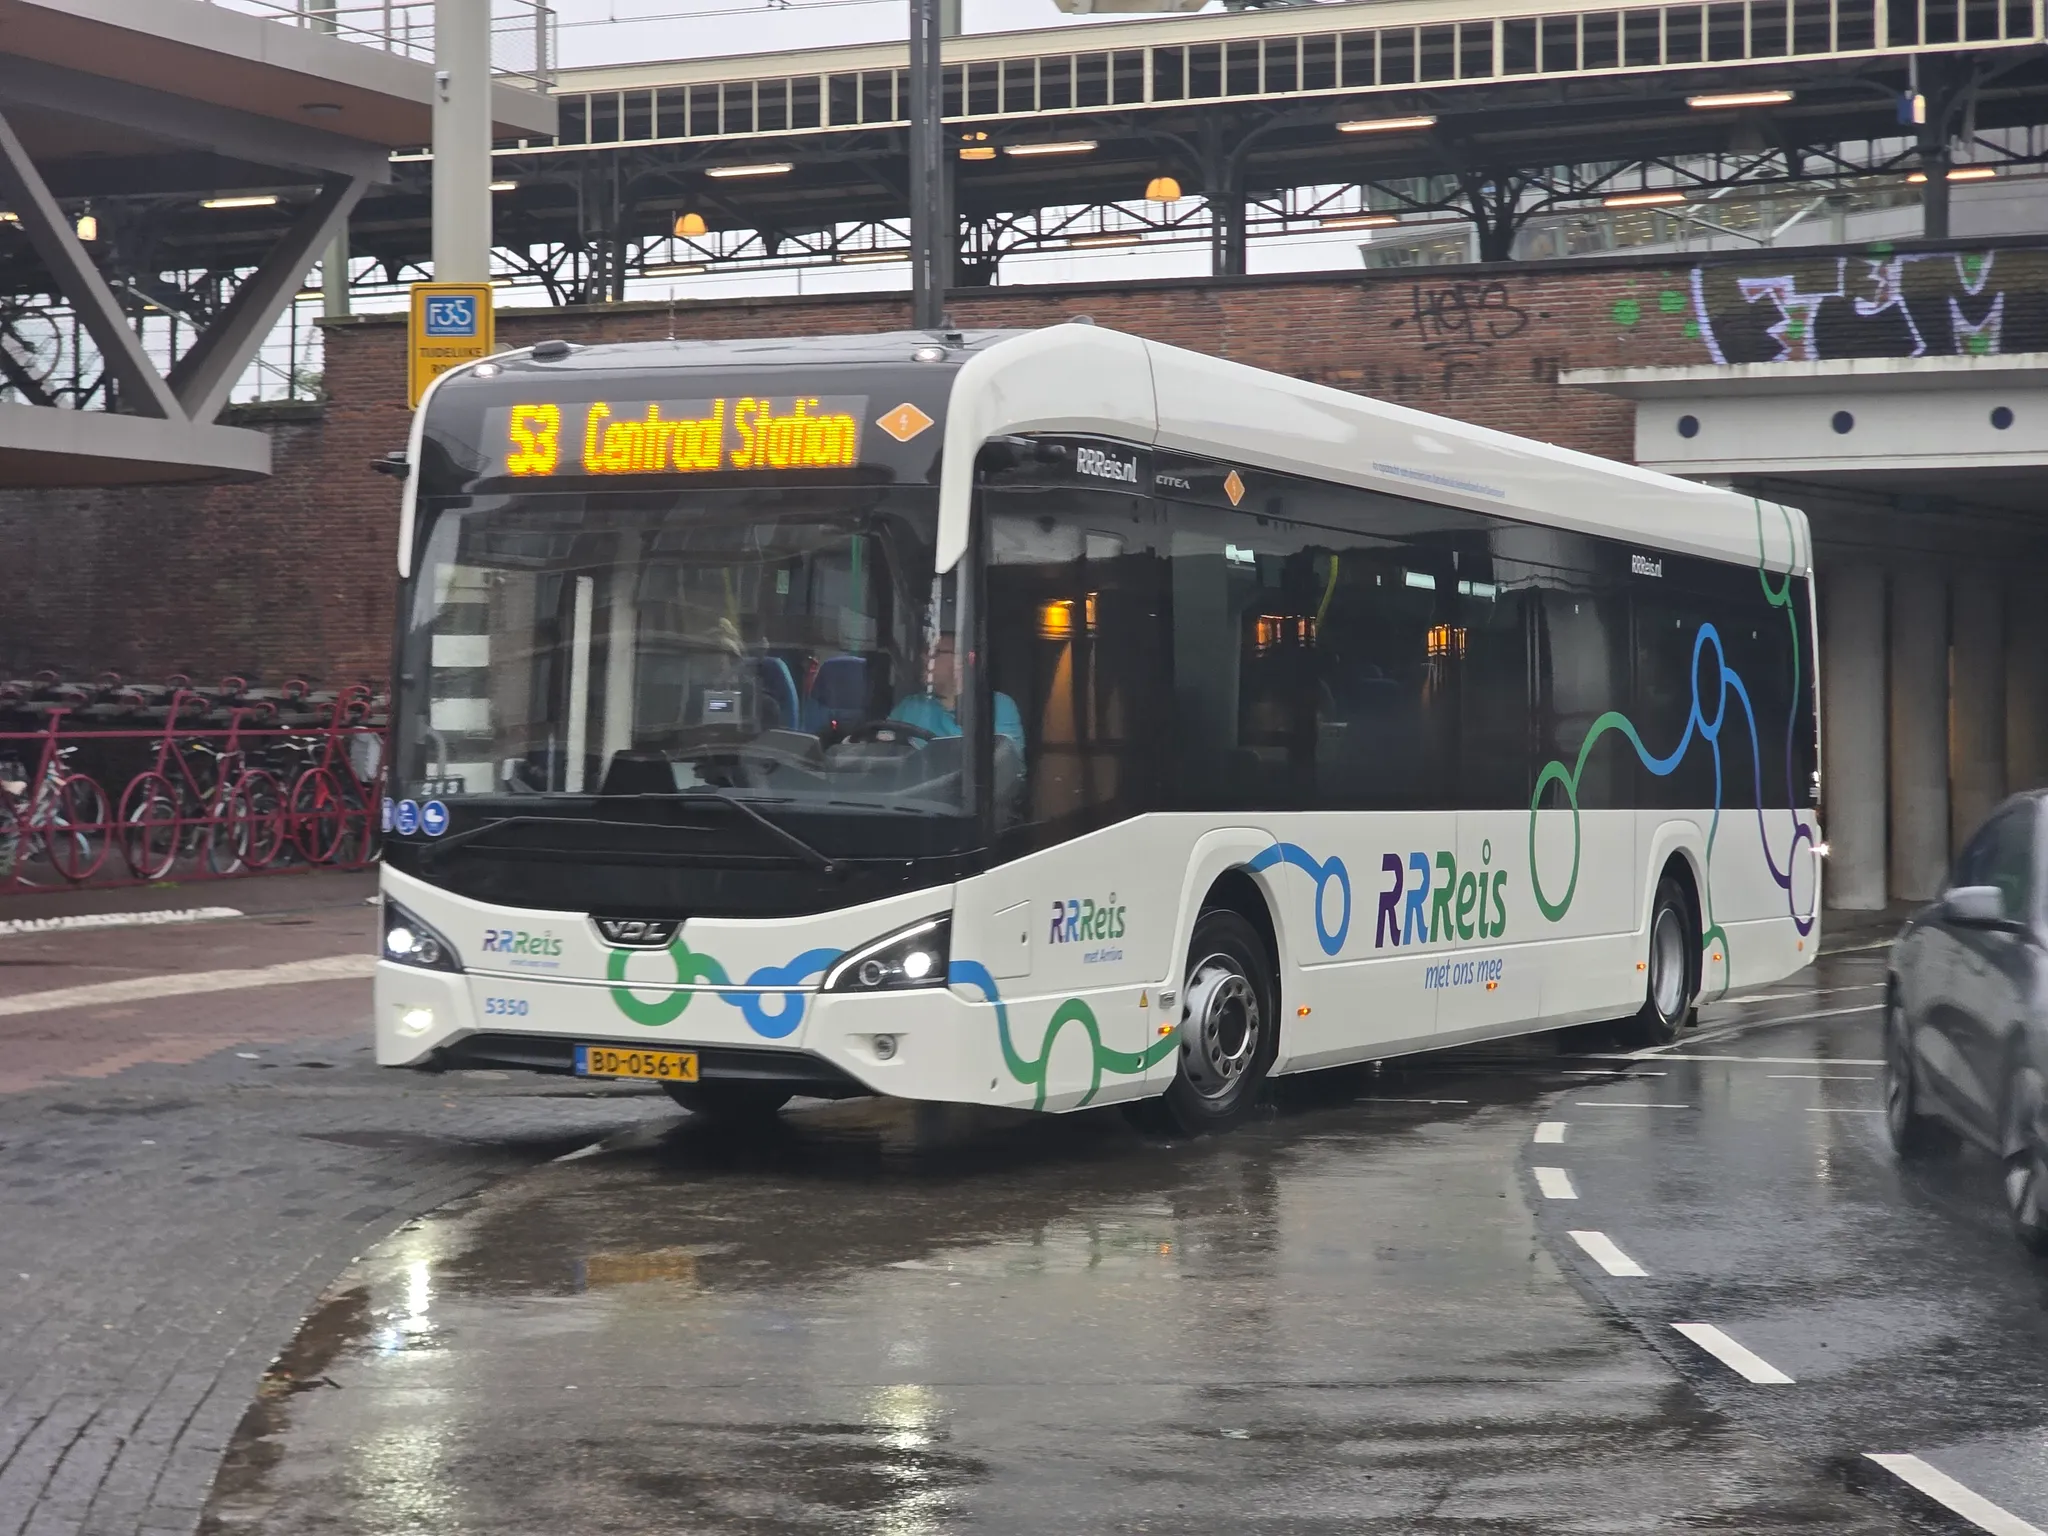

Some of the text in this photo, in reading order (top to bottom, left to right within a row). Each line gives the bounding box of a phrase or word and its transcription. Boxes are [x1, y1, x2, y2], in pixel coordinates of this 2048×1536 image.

[429, 299, 472, 326] F35
[507, 403, 560, 475] 53
[730, 396, 855, 467] Station
[1077, 447, 1138, 483] RRReis.nl
[1375, 838, 1508, 948] RRReis
[602, 920, 667, 940] VDL
[1049, 891, 1127, 944] RRReis
[482, 929, 563, 956] RRReis
[1425, 958, 1503, 989] met ons mee
[485, 997, 529, 1016] 5350
[592, 1051, 693, 1077] BD-056-K
